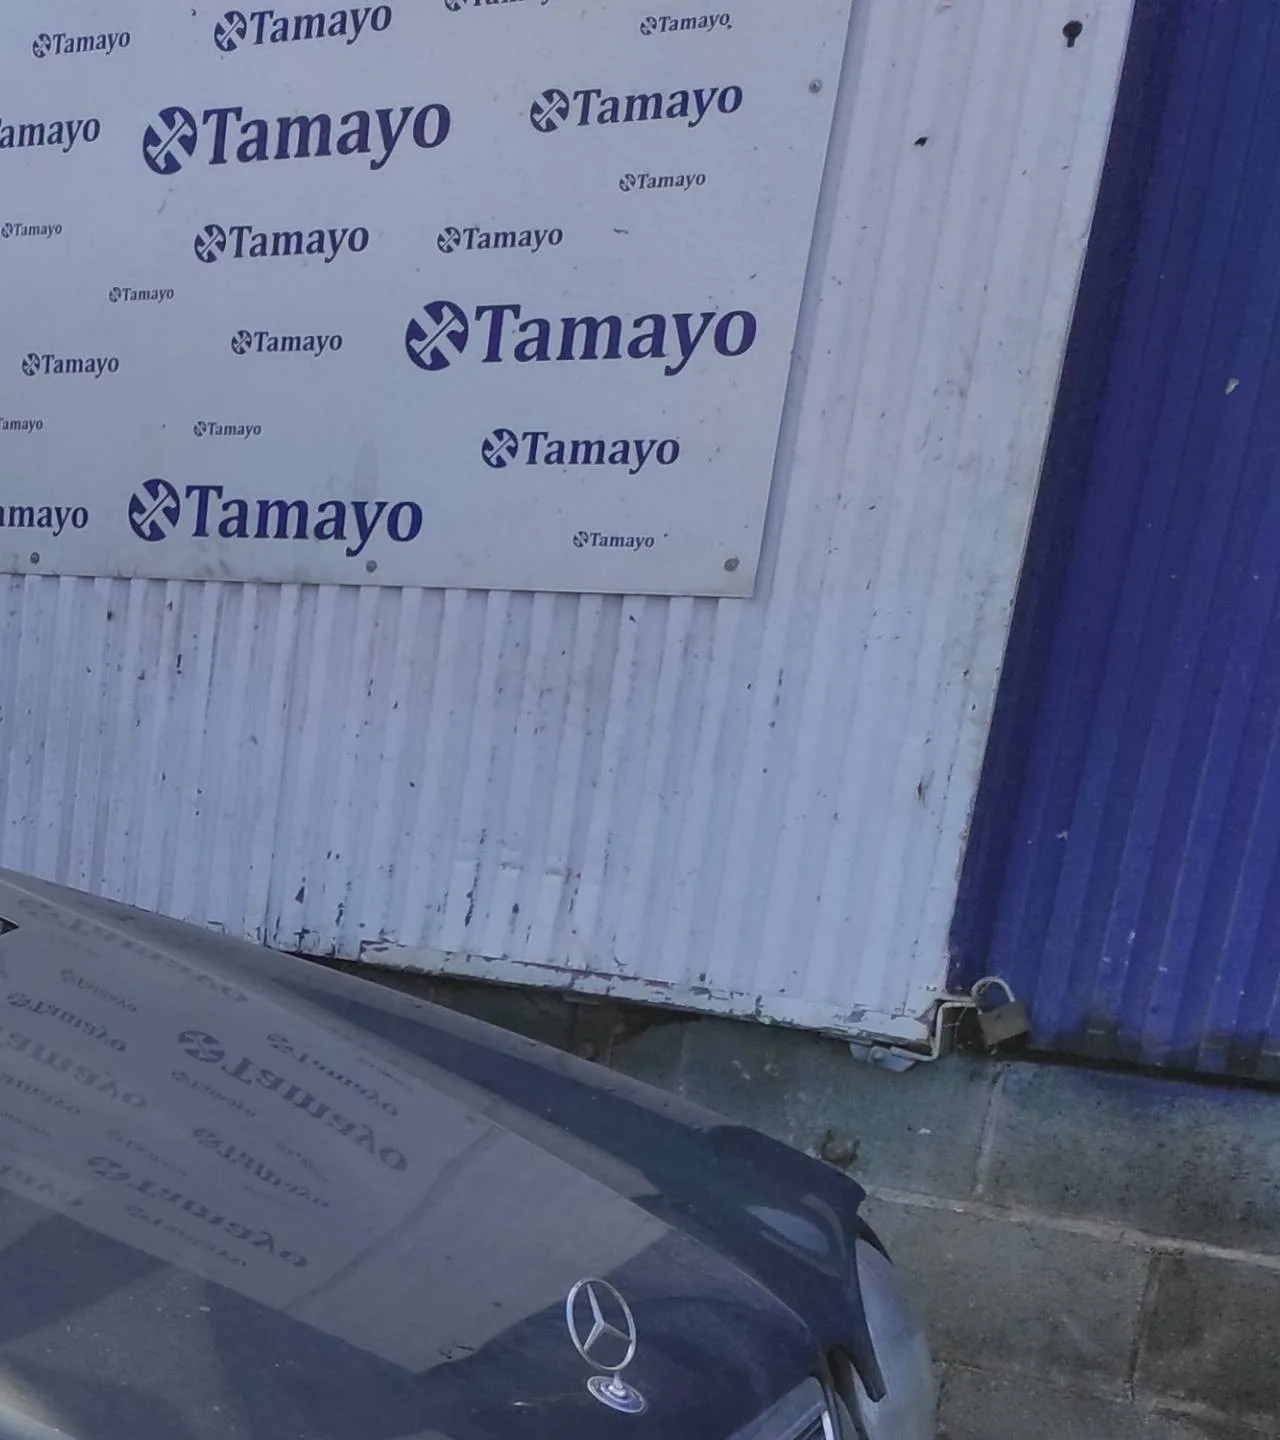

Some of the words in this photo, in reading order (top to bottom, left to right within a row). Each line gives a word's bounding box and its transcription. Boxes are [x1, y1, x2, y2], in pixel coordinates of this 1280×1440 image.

[250, 5, 391, 45] Tamayo
[659, 14, 729, 32] Tamayo
[53, 32, 130, 55] Tamayo
[573, 86, 742, 127] Tamayo
[203, 104, 450, 170] Tamayo
[638, 174, 705, 190] Tamayo
[14, 224, 62, 238] Tamayo
[463, 228, 562, 253] Tamayo
[229, 226, 369, 263] Tamayo
[123, 288, 174, 303] Tamayo
[254, 332, 342, 357] Tamayo
[475, 304, 756, 376] Tamayo
[42, 355, 119, 378] Tamayo
[208, 422, 261, 439] Tamayo
[522, 432, 679, 474] Tamayo
[185, 485, 422, 557] Tamayo
[590, 533, 654, 551] Tamayo
